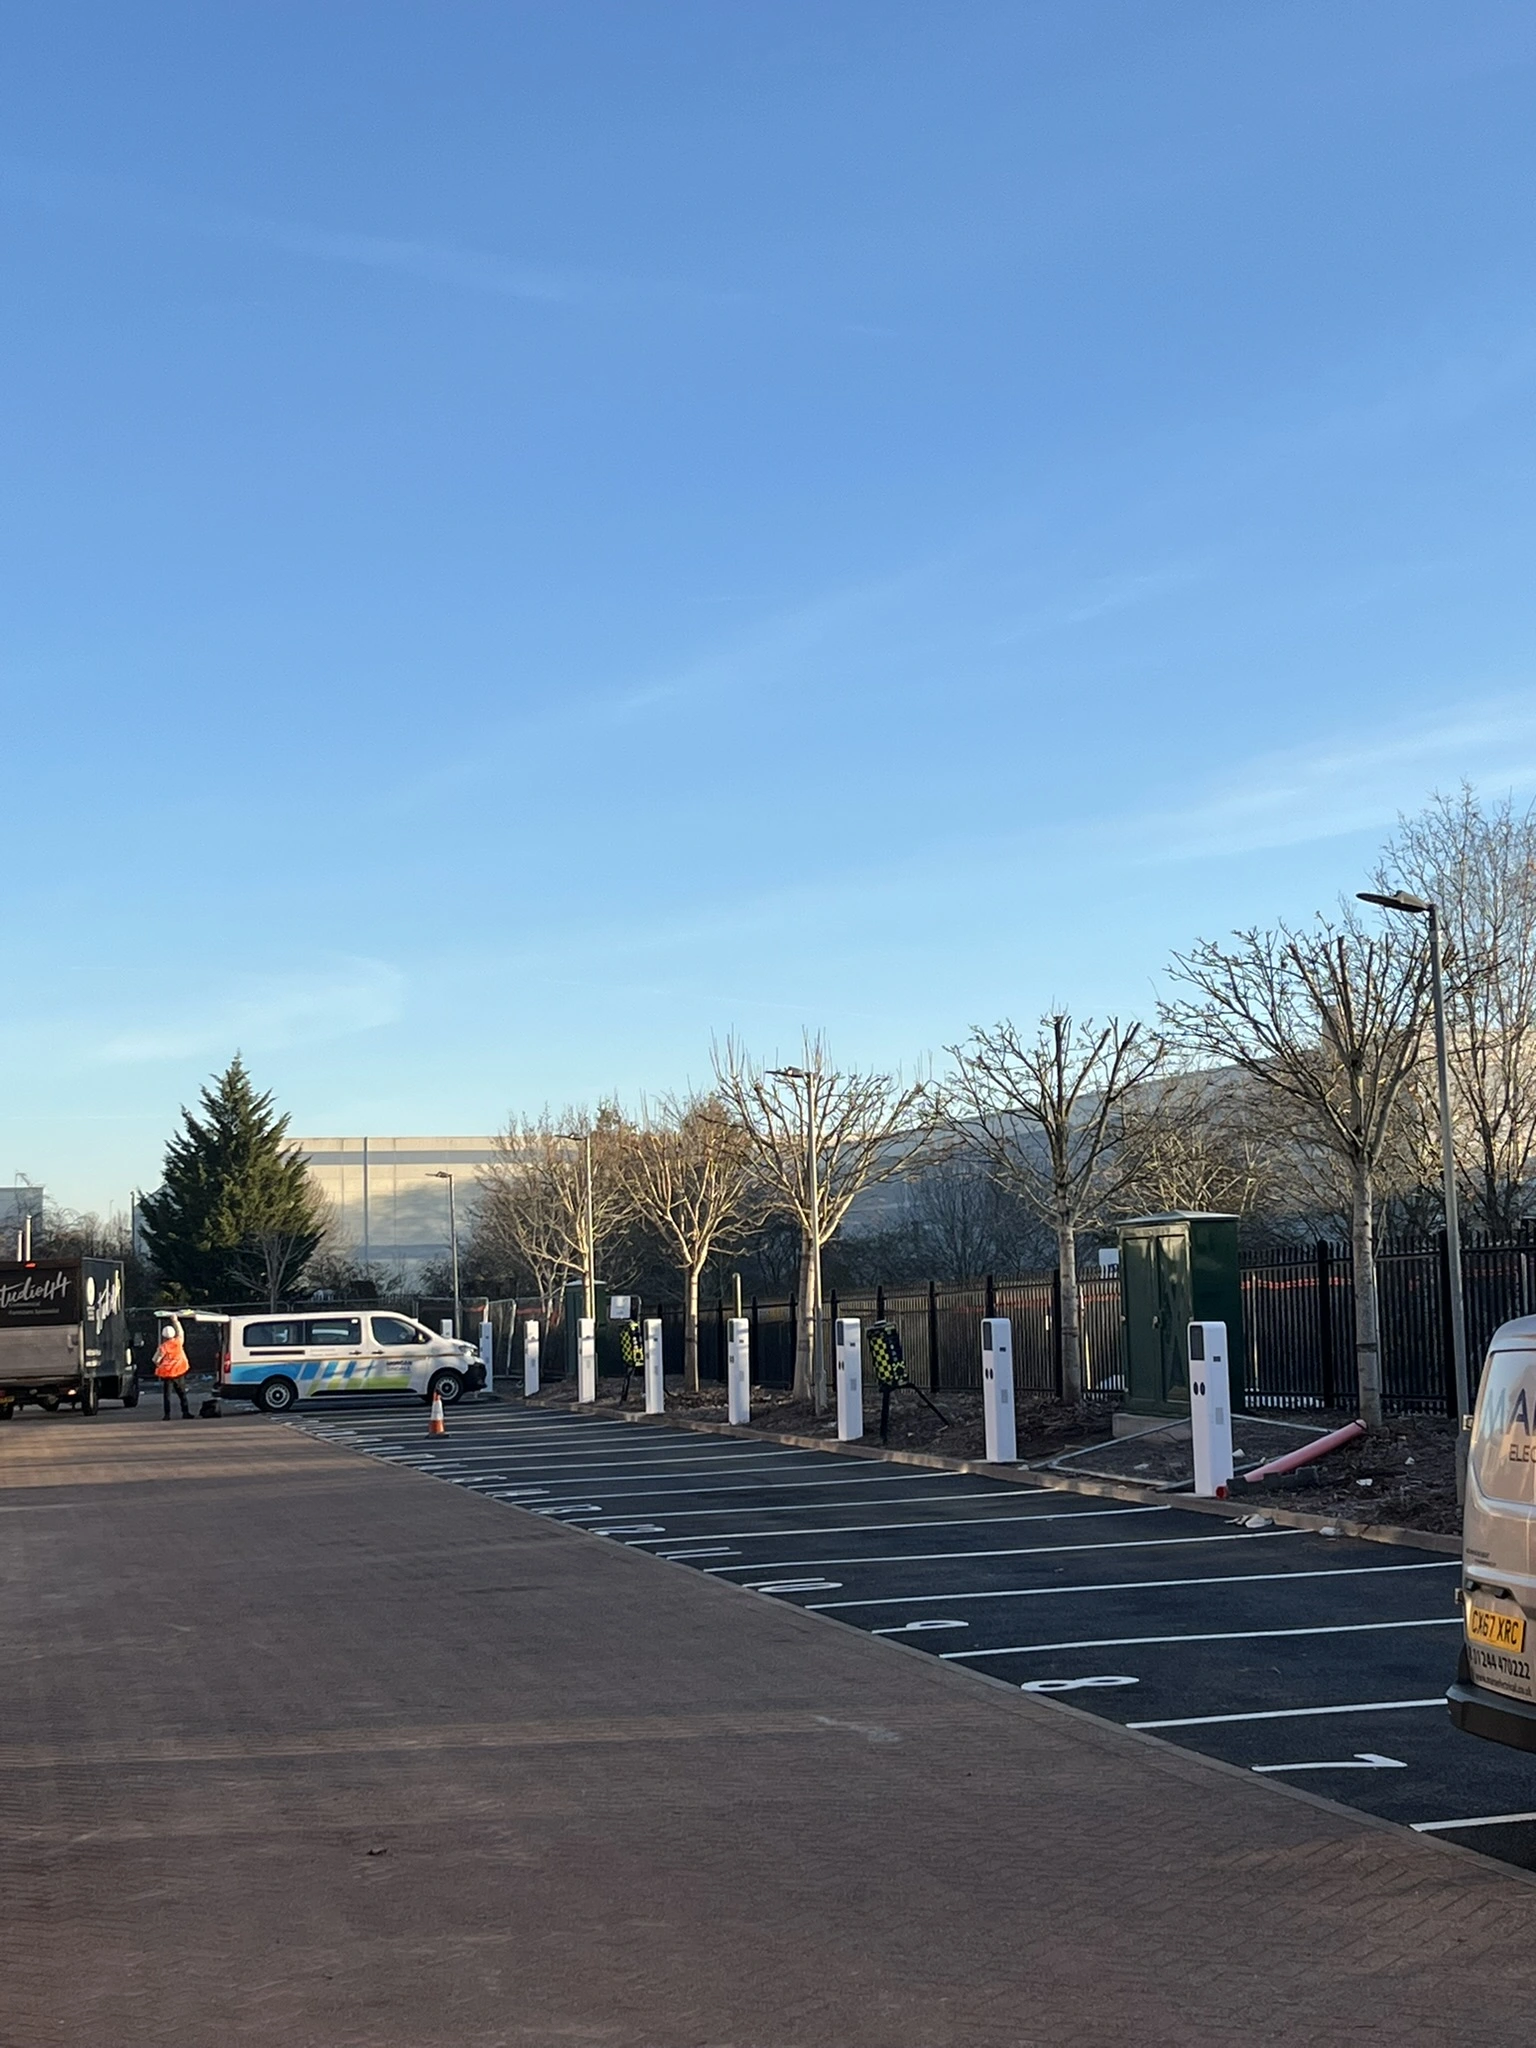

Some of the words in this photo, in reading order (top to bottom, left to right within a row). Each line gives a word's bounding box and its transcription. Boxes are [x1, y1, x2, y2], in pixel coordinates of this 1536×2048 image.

[0, 1271, 71, 1308] tudio44
[1480, 1387, 1536, 1438] MA
[1472, 1610, 1495, 1638] CX67
[1497, 1617, 1519, 1645] XRC
[1021, 1675, 1140, 1691] 8
